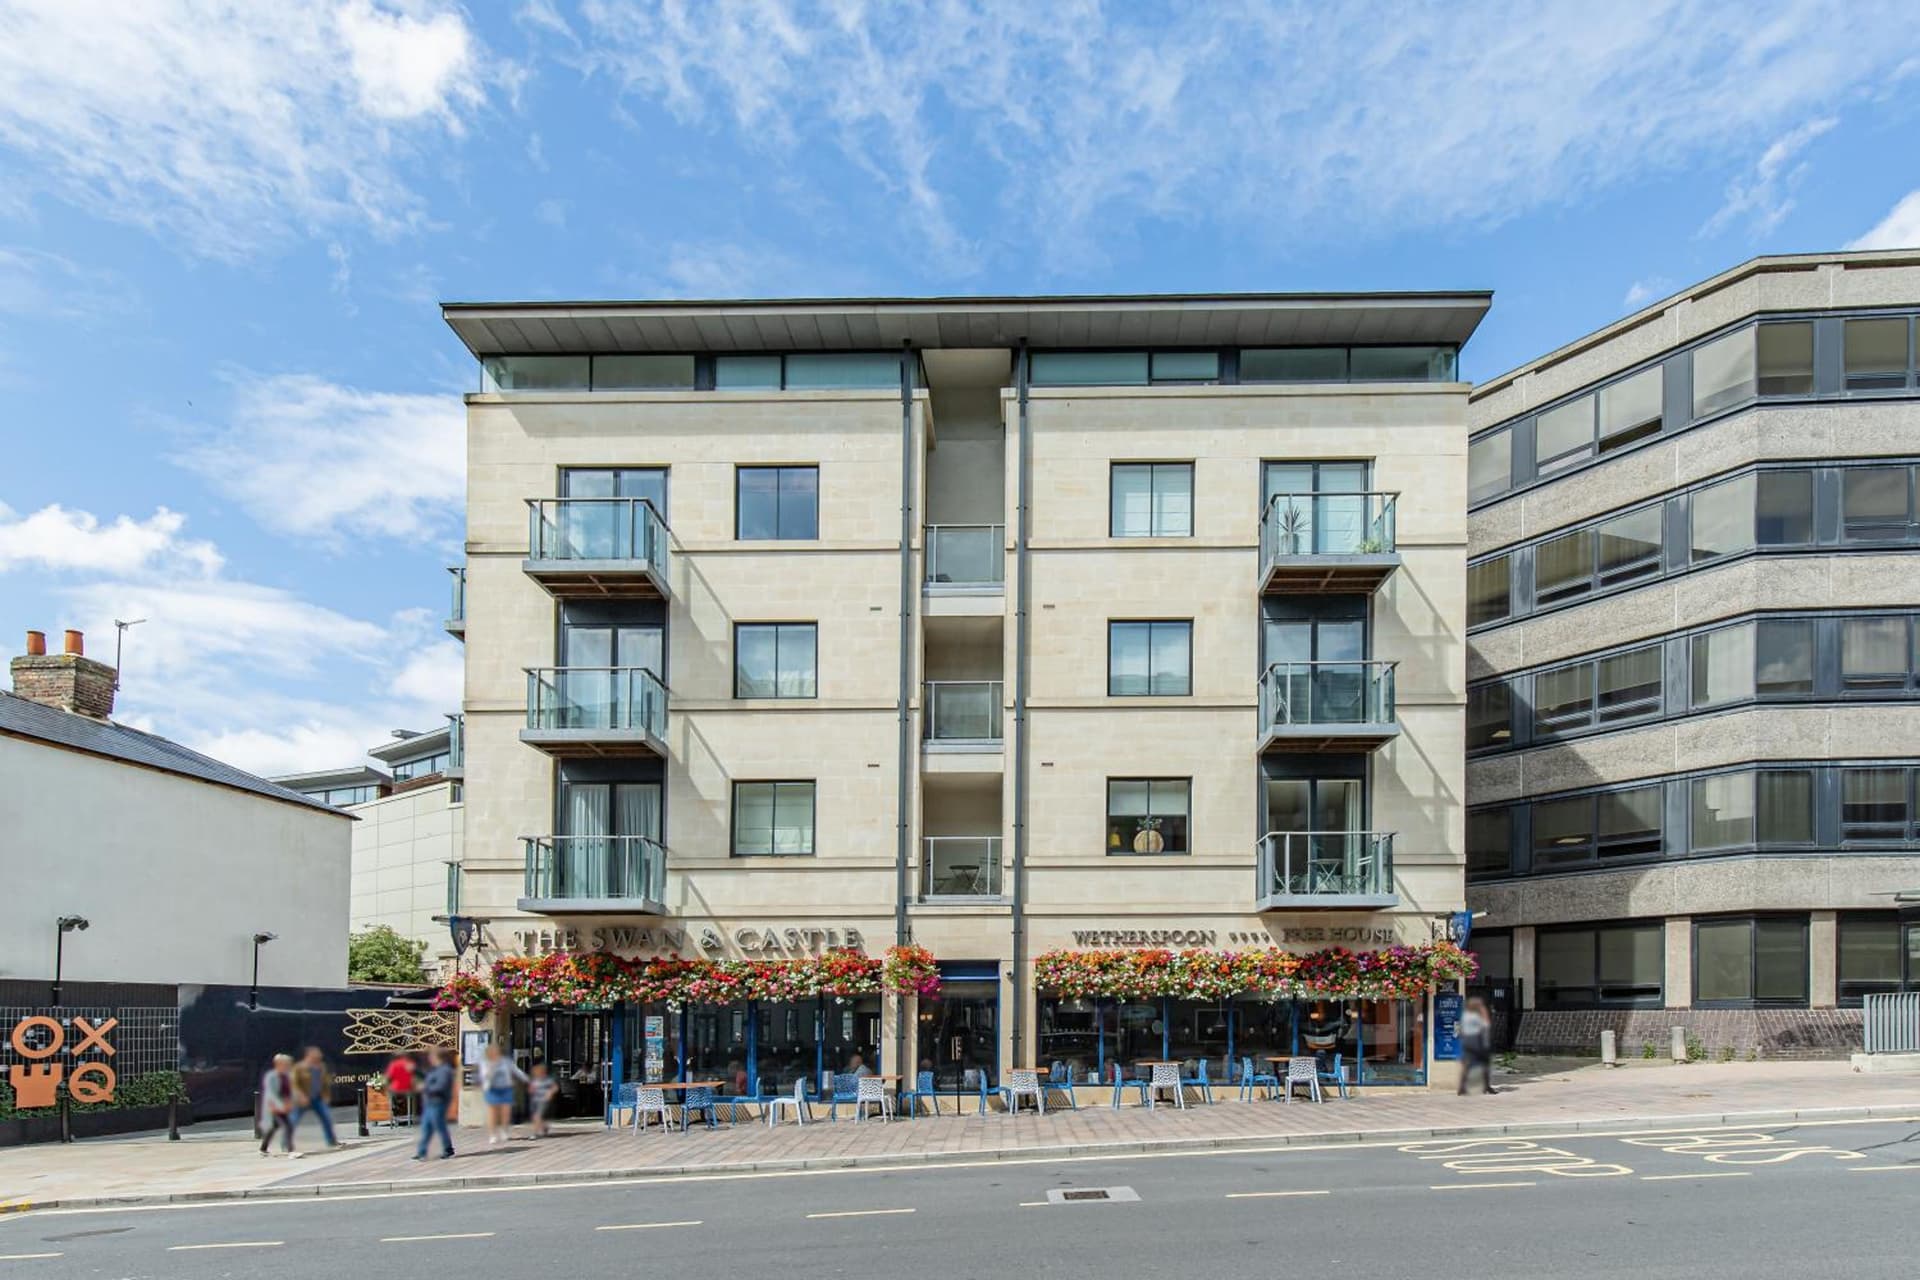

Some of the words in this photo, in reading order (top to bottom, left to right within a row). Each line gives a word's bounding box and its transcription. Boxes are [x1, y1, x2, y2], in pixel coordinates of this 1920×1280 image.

[513, 928, 578, 951] THE
[592, 927, 687, 950] SWAN
[701, 927, 722, 949] &
[735, 926, 865, 951] CASTLE
[1072, 930, 1217, 947] WETHERSPOON
[1282, 927, 1325, 944] FREE
[1328, 928, 1394, 945] HOUSE
[331, 1073, 356, 1084] ome
[357, 1072, 371, 1082] on
[1397, 1140, 1634, 1177] STOP
[1619, 1132, 1868, 1165] BUS
